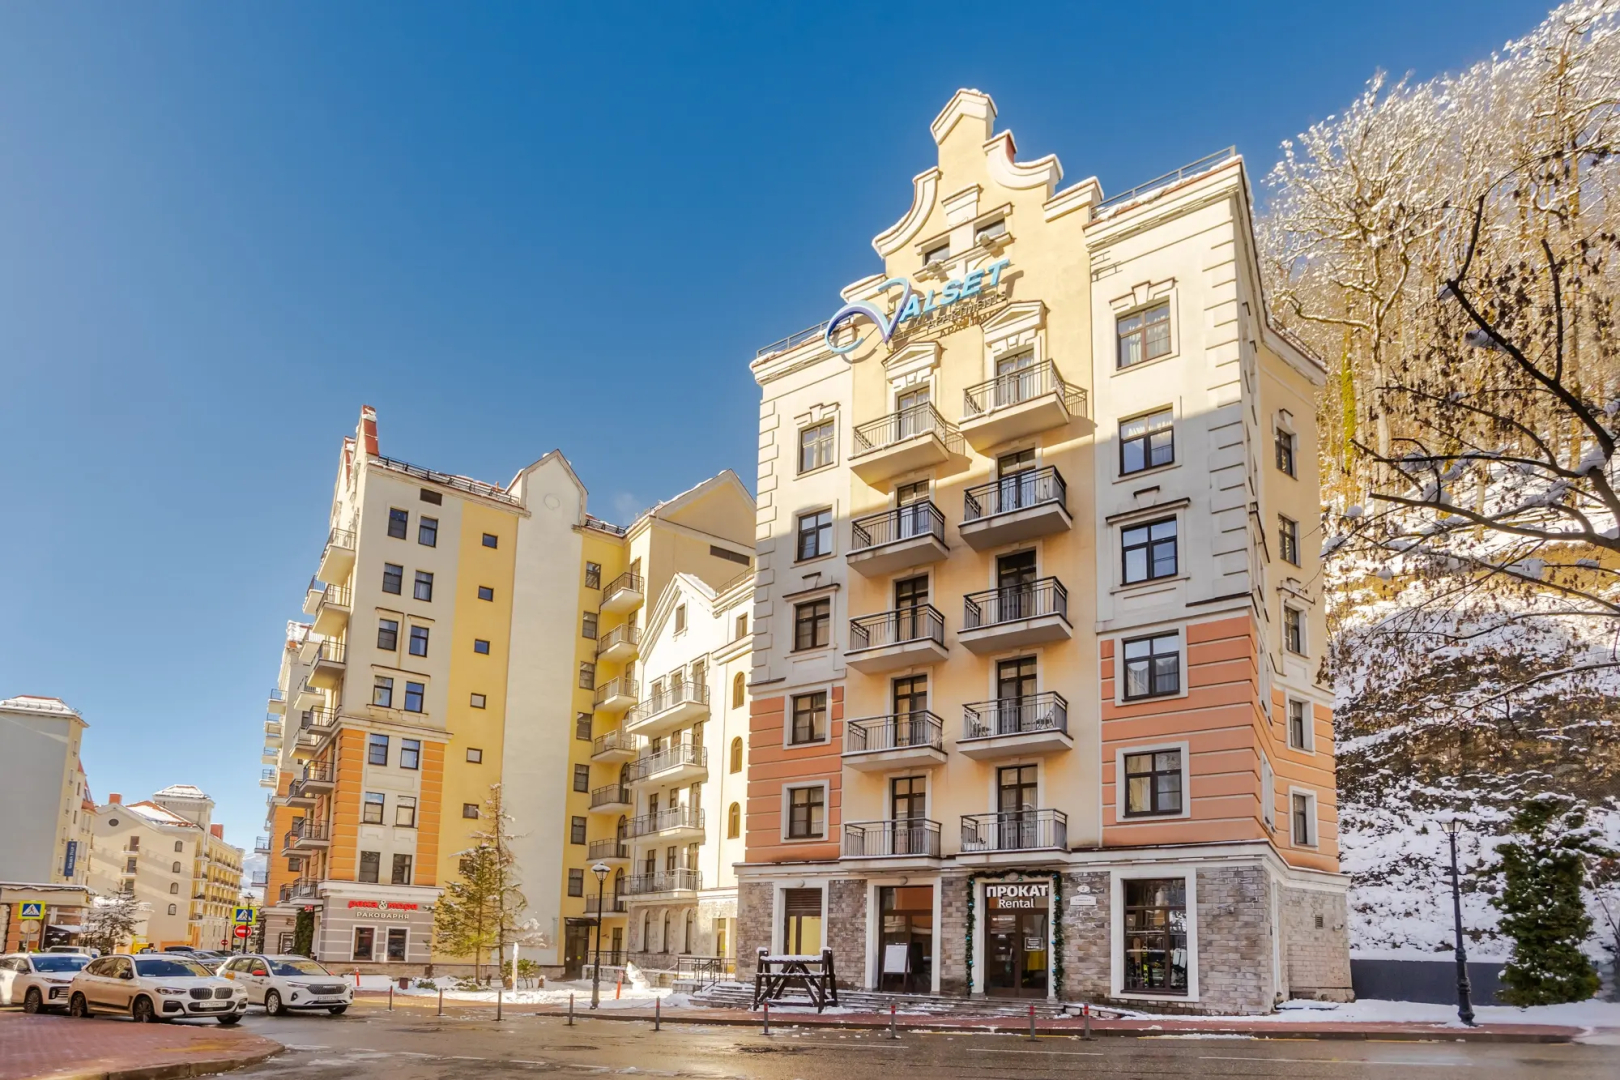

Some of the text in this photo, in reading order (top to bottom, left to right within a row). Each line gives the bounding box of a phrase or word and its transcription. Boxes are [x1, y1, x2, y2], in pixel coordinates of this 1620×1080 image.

[825, 258, 1010, 354] VALSET
[986, 885, 1049, 897] ПРОКАТ
[379, 899, 388, 910] &
[998, 898, 1035, 909] Rental
[356, 911, 410, 919] РАКОВАРНЯ
